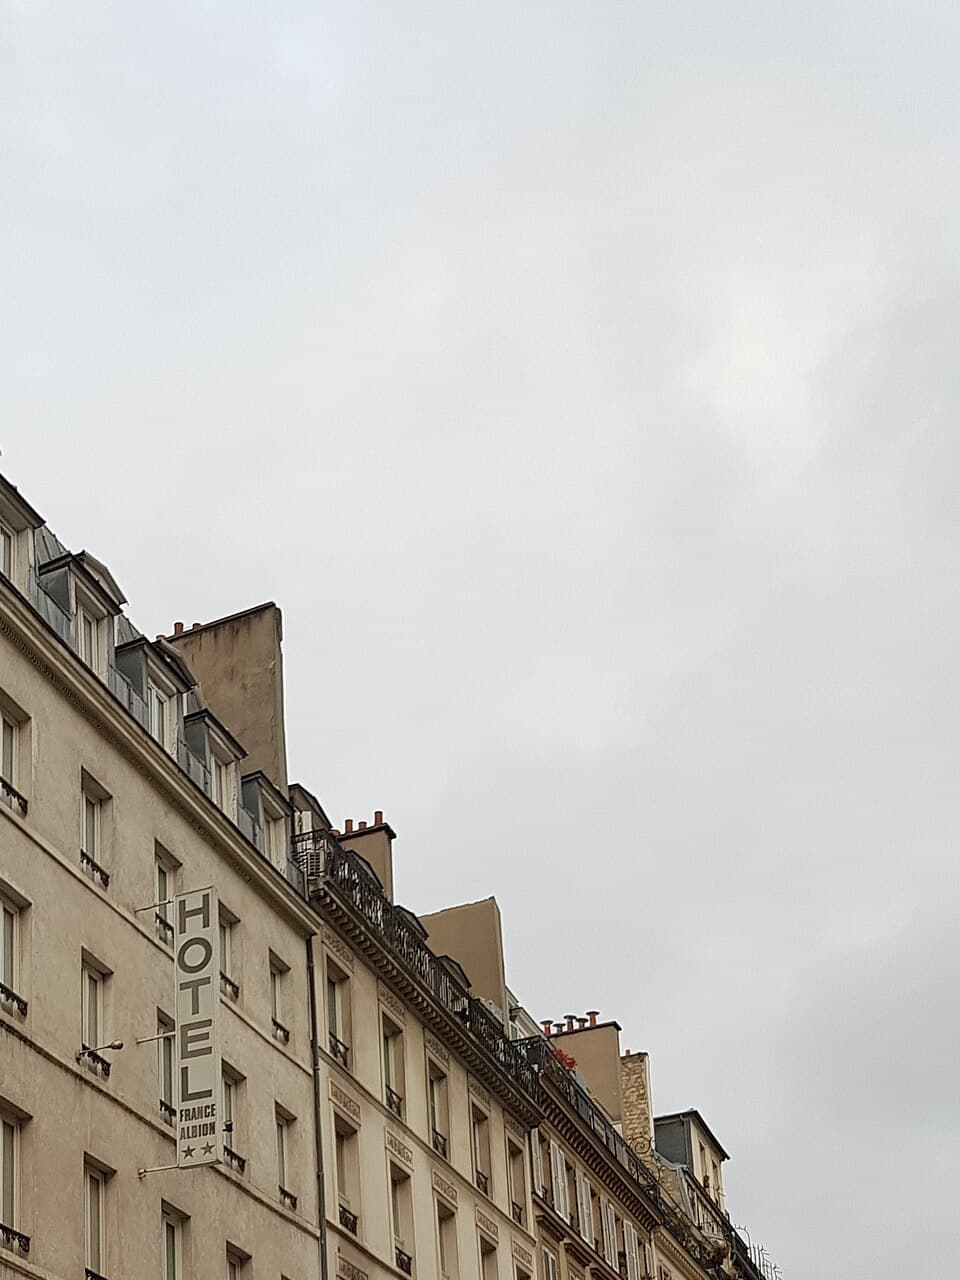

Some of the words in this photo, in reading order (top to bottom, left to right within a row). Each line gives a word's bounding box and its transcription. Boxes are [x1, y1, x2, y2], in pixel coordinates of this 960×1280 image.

[177, 893, 214, 1103] HOTEL
[180, 1103, 216, 1122] FRANCE
[180, 1121, 216, 1140] ALBION
